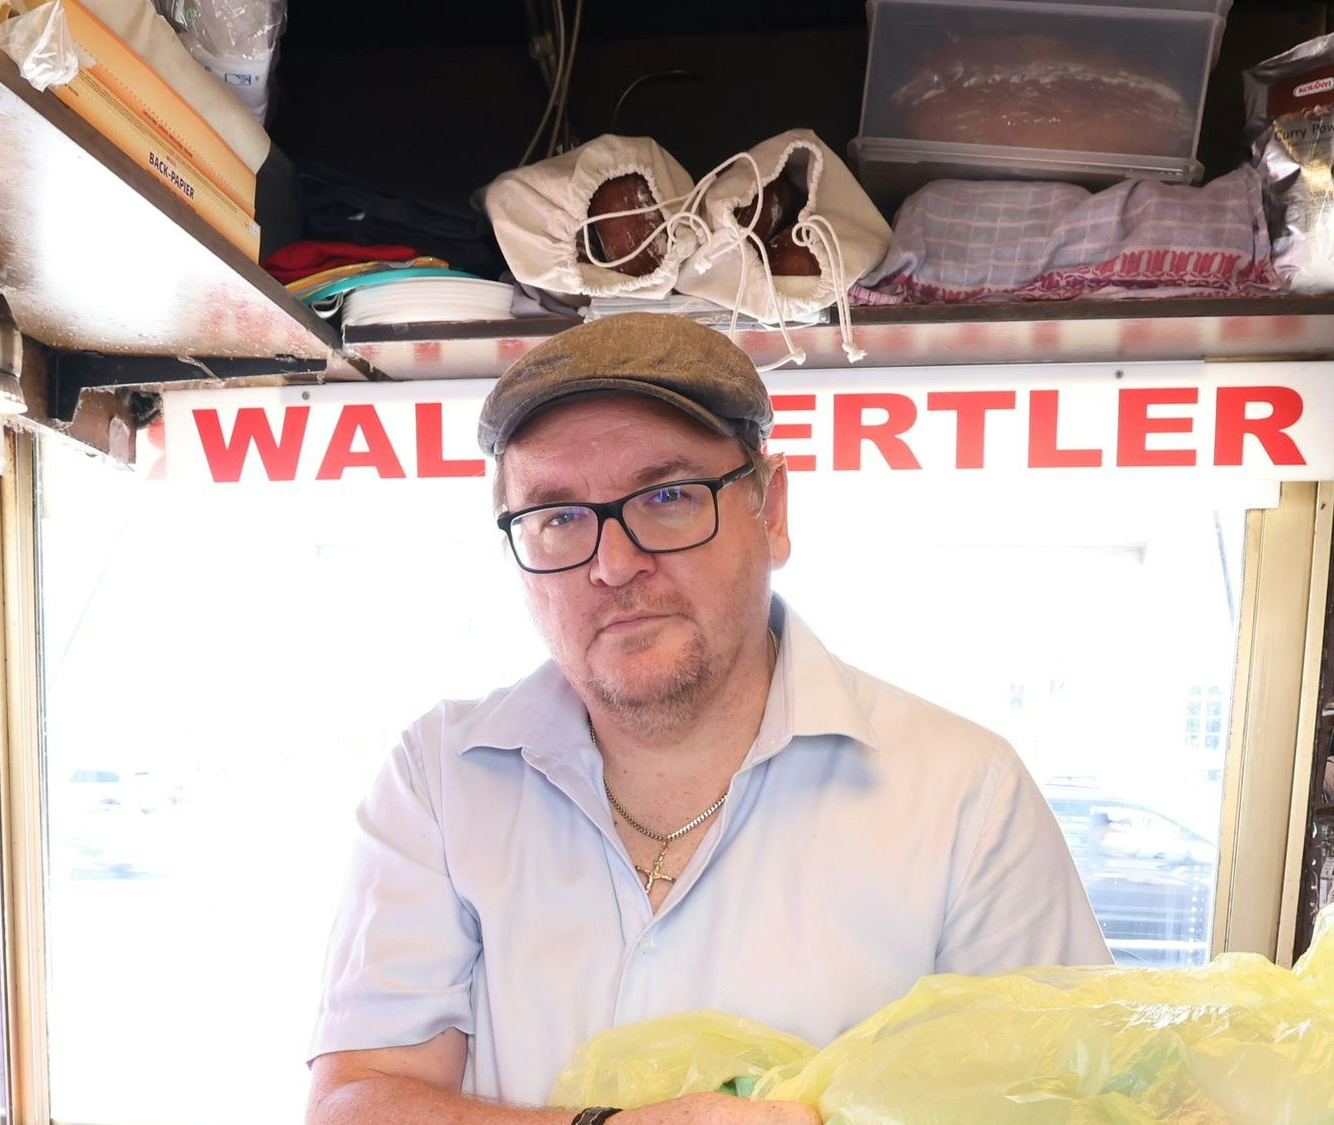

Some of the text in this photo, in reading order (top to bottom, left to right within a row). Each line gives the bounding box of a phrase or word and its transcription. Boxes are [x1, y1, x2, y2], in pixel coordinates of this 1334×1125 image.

[1274, 128, 1307, 143] Curry
[148, 151, 196, 201] BACK-PAPIER
[192, 385, 1309, 483] WALERTLER
